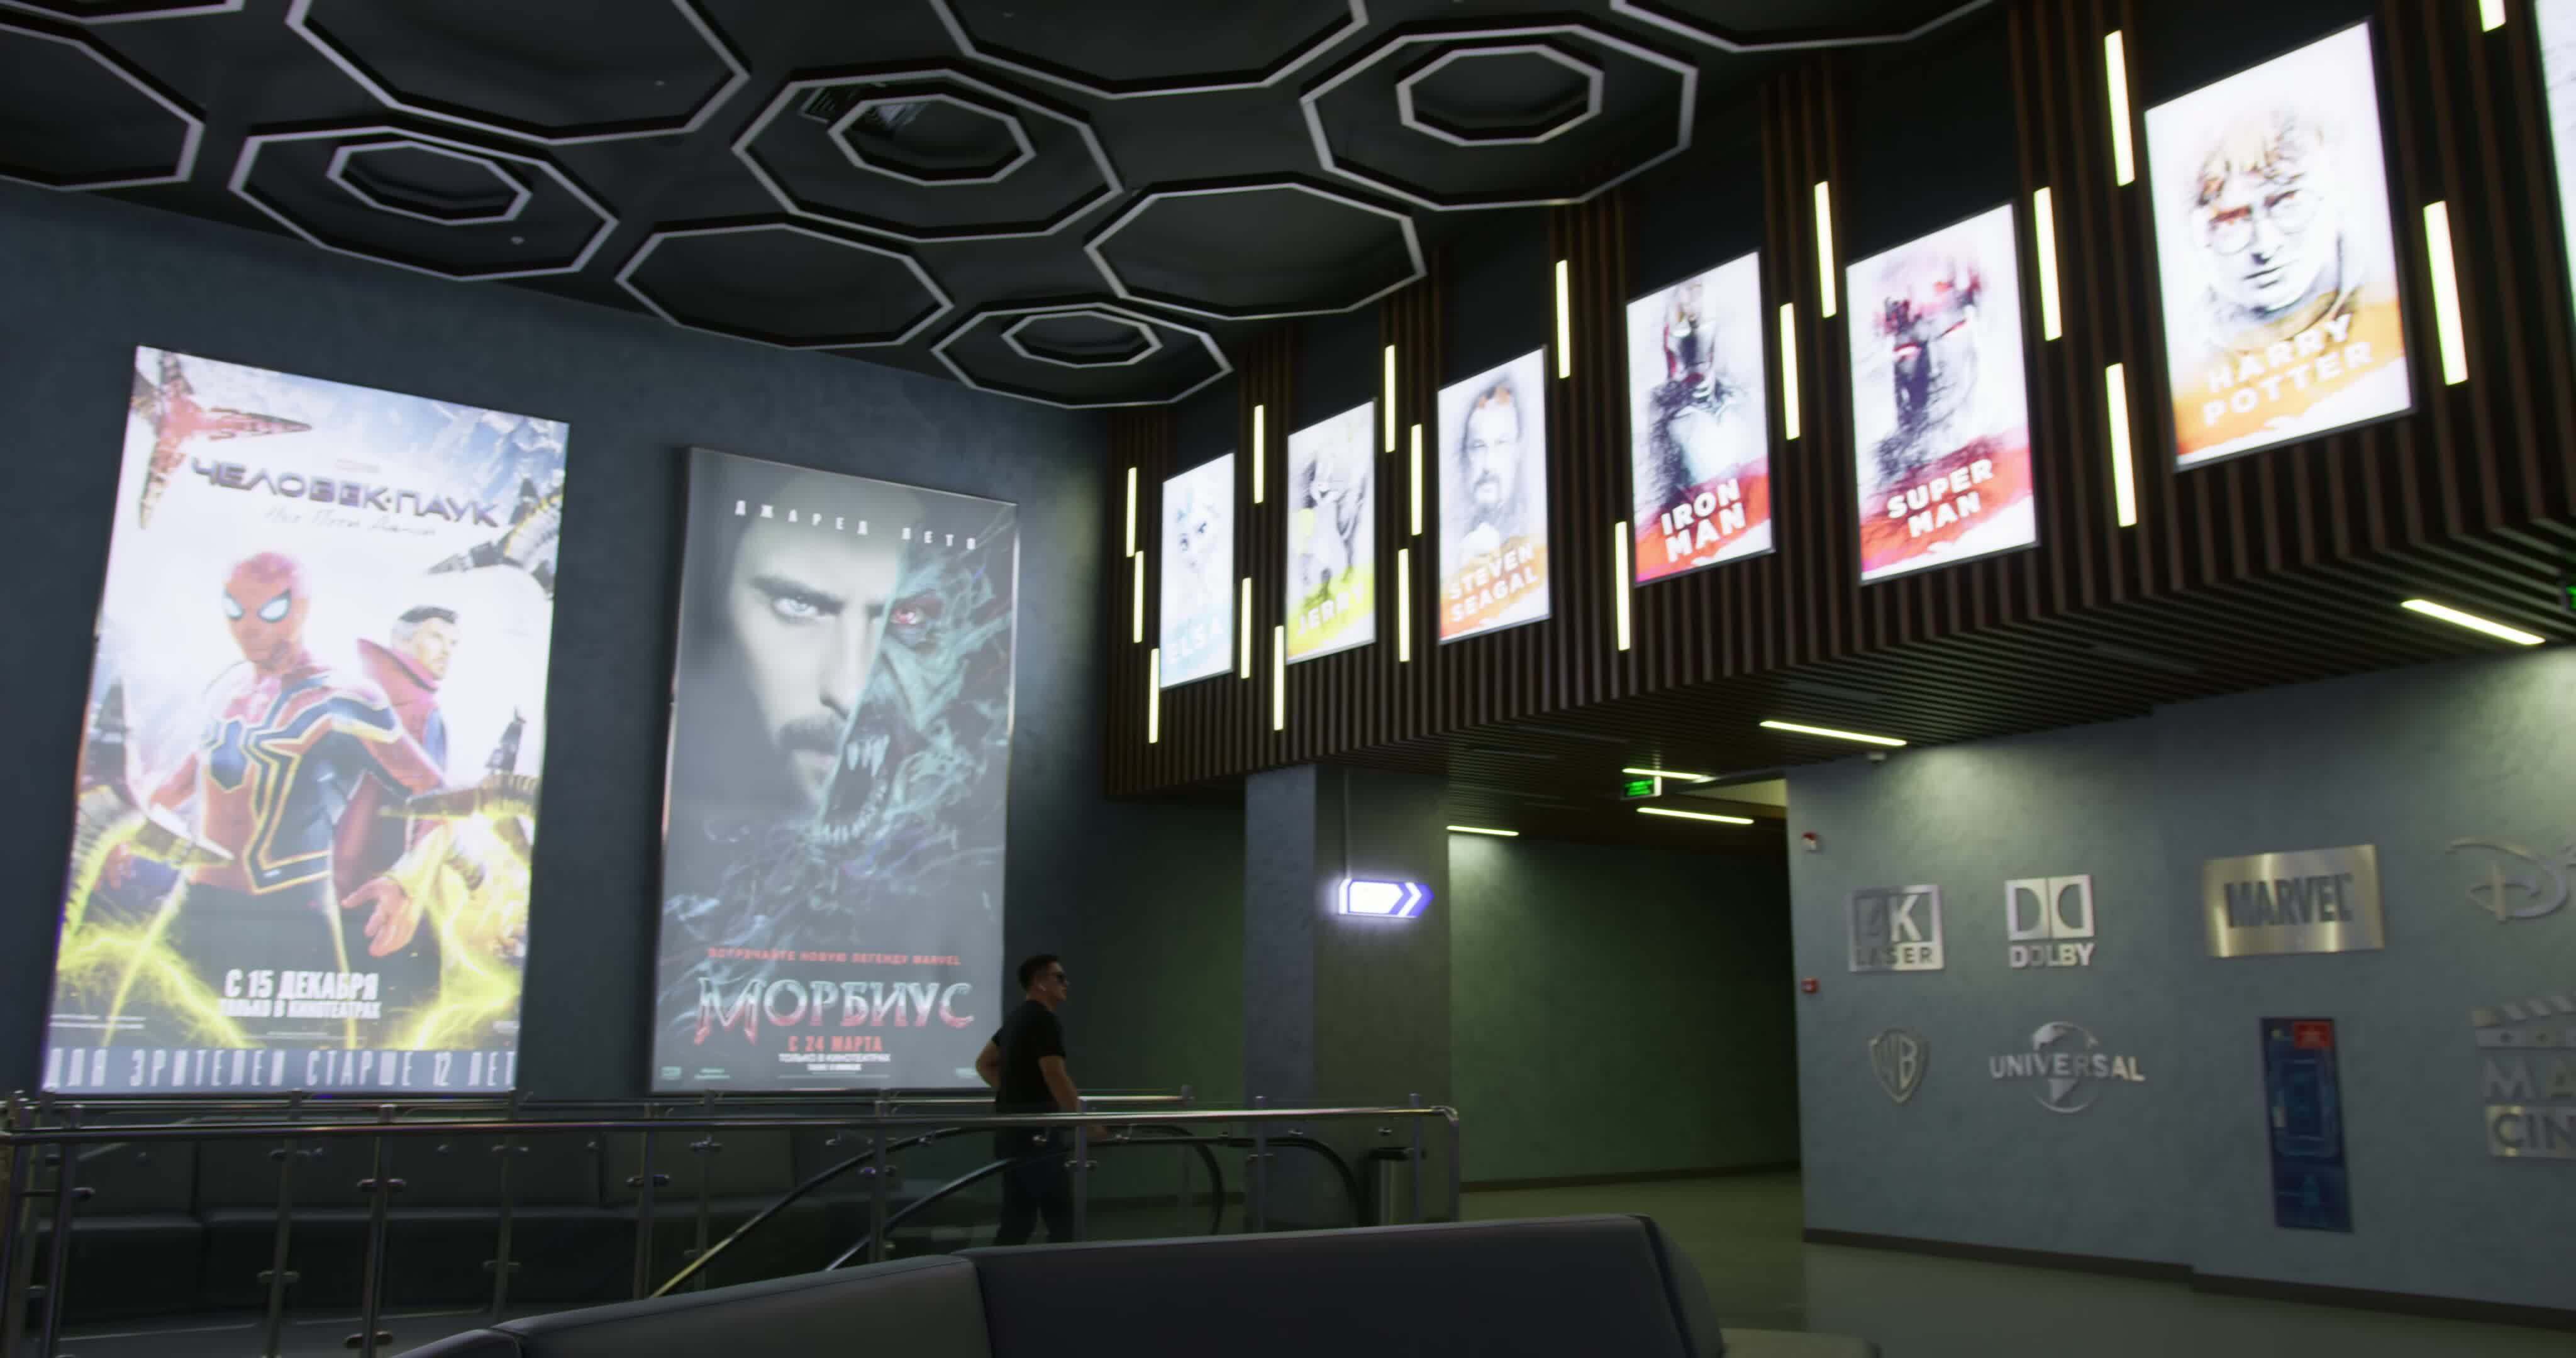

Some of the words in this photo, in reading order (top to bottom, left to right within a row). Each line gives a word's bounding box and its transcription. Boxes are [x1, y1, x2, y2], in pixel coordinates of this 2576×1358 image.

[2208, 313, 2353, 393] HARRY
[2203, 342, 2372, 426] POTTER
[1661, 478, 1740, 536] IRON
[1887, 459, 1993, 518] SUPER
[735, 500, 868, 536] ДЖАРЕД
[902, 527, 976, 550] ЛЕТО
[1665, 502, 1746, 563] MAN
[1908, 491, 1981, 538] MAN
[1448, 543, 1533, 599] STEVEN
[1450, 567, 1538, 622] SEAGAL
[1297, 581, 1366, 634] JERRY
[1855, 894, 1922, 942] 4K
[2224, 873, 2353, 928] MARVEL
[912, 954, 962, 966] MARVEL
[1856, 946, 1933, 966] LASER
[2009, 942, 2096, 968] DOLBY
[225, 969, 243, 998] С
[248, 970, 275, 998] 15
[277, 970, 379, 1000] ДЕКАБРЯ
[694, 976, 974, 1046] МОРБИУС
[42, 1047, 108, 1091] ДЛЯ
[306, 1049, 414, 1086] СТАРШЕ
[432, 1051, 452, 1086] 12
[468, 1051, 516, 1086] ЛЕТ
[788, 1036, 799, 1052] С
[805, 1036, 825, 1052] 24
[831, 1036, 882, 1052] МАРТА
[1989, 1052, 2145, 1081] UNIVERSAL
